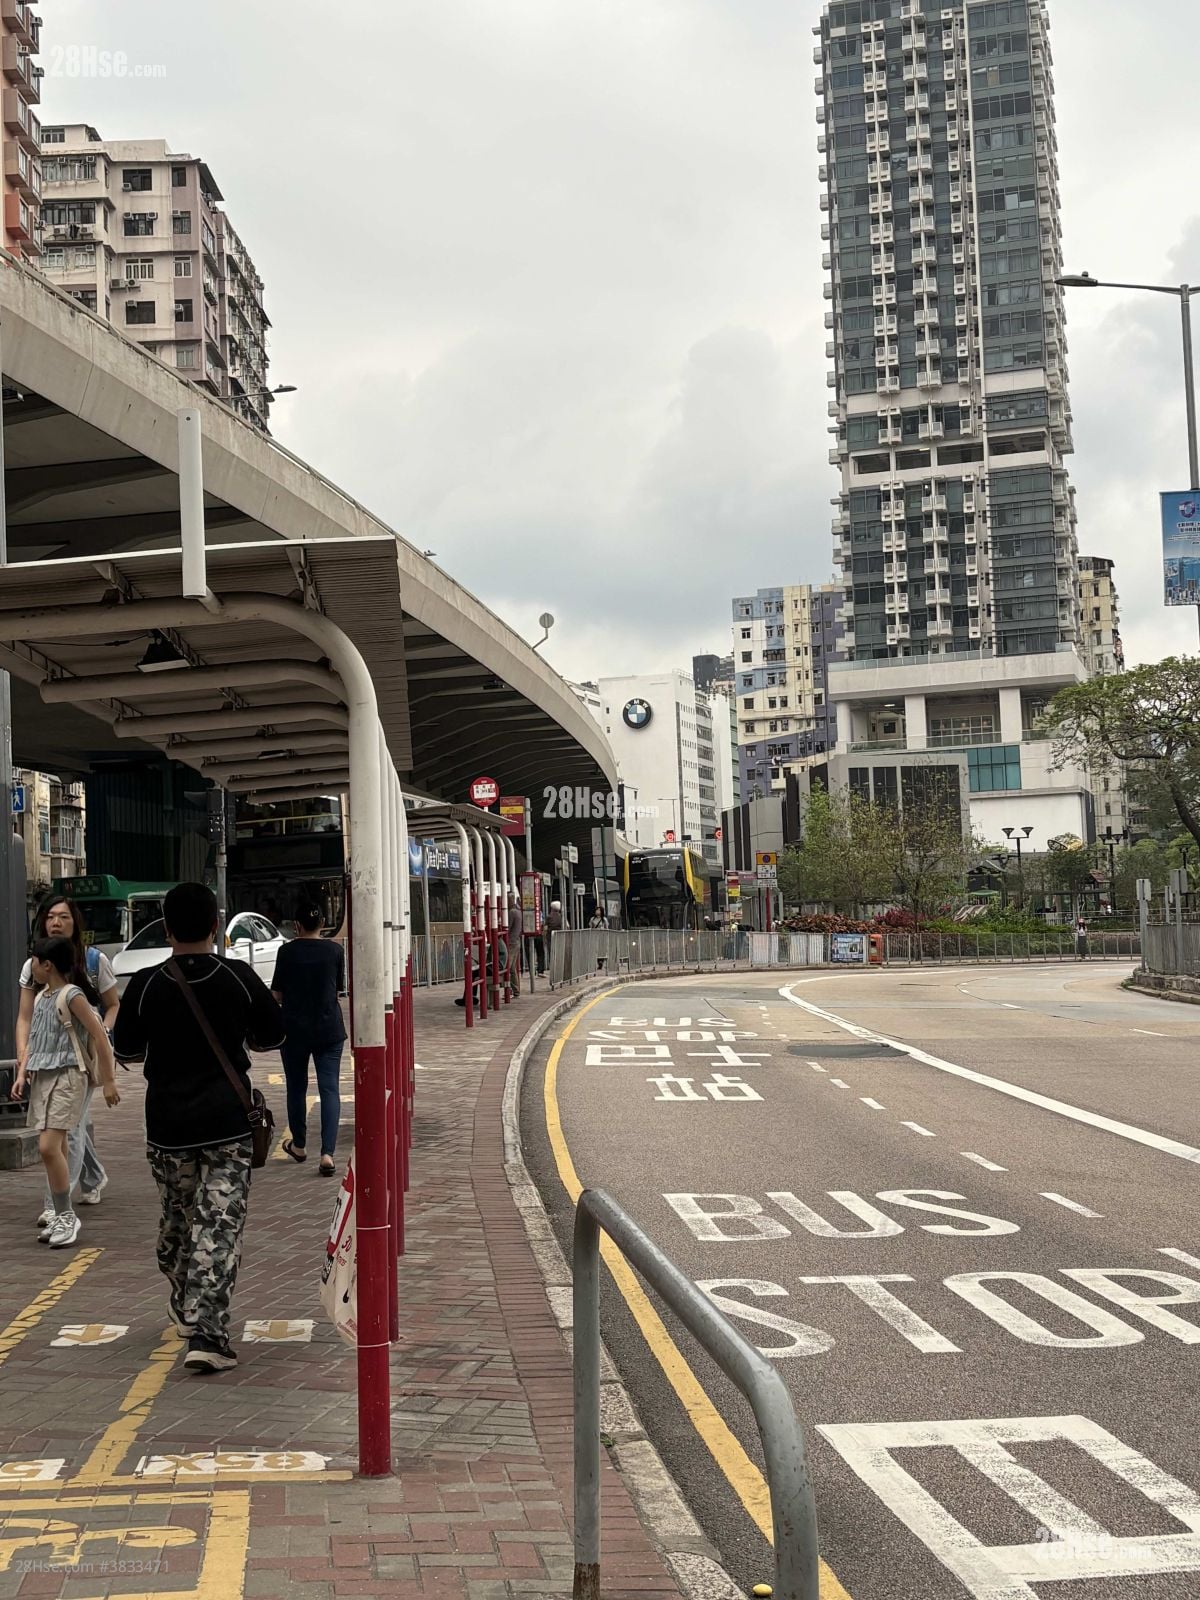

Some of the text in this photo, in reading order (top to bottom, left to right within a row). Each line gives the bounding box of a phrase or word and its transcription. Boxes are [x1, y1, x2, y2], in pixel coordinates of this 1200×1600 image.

[625, 699, 649, 710] BMW
[608, 1016, 738, 1027] BUS
[586, 1030, 759, 1042] STOP
[585, 1044, 772, 1066] 巴士
[646, 1073, 765, 1100] 站
[662, 1189, 1020, 1241] BUS
[694, 1268, 1200, 1359] STOP
[159, 1452, 306, 1473] 85X
